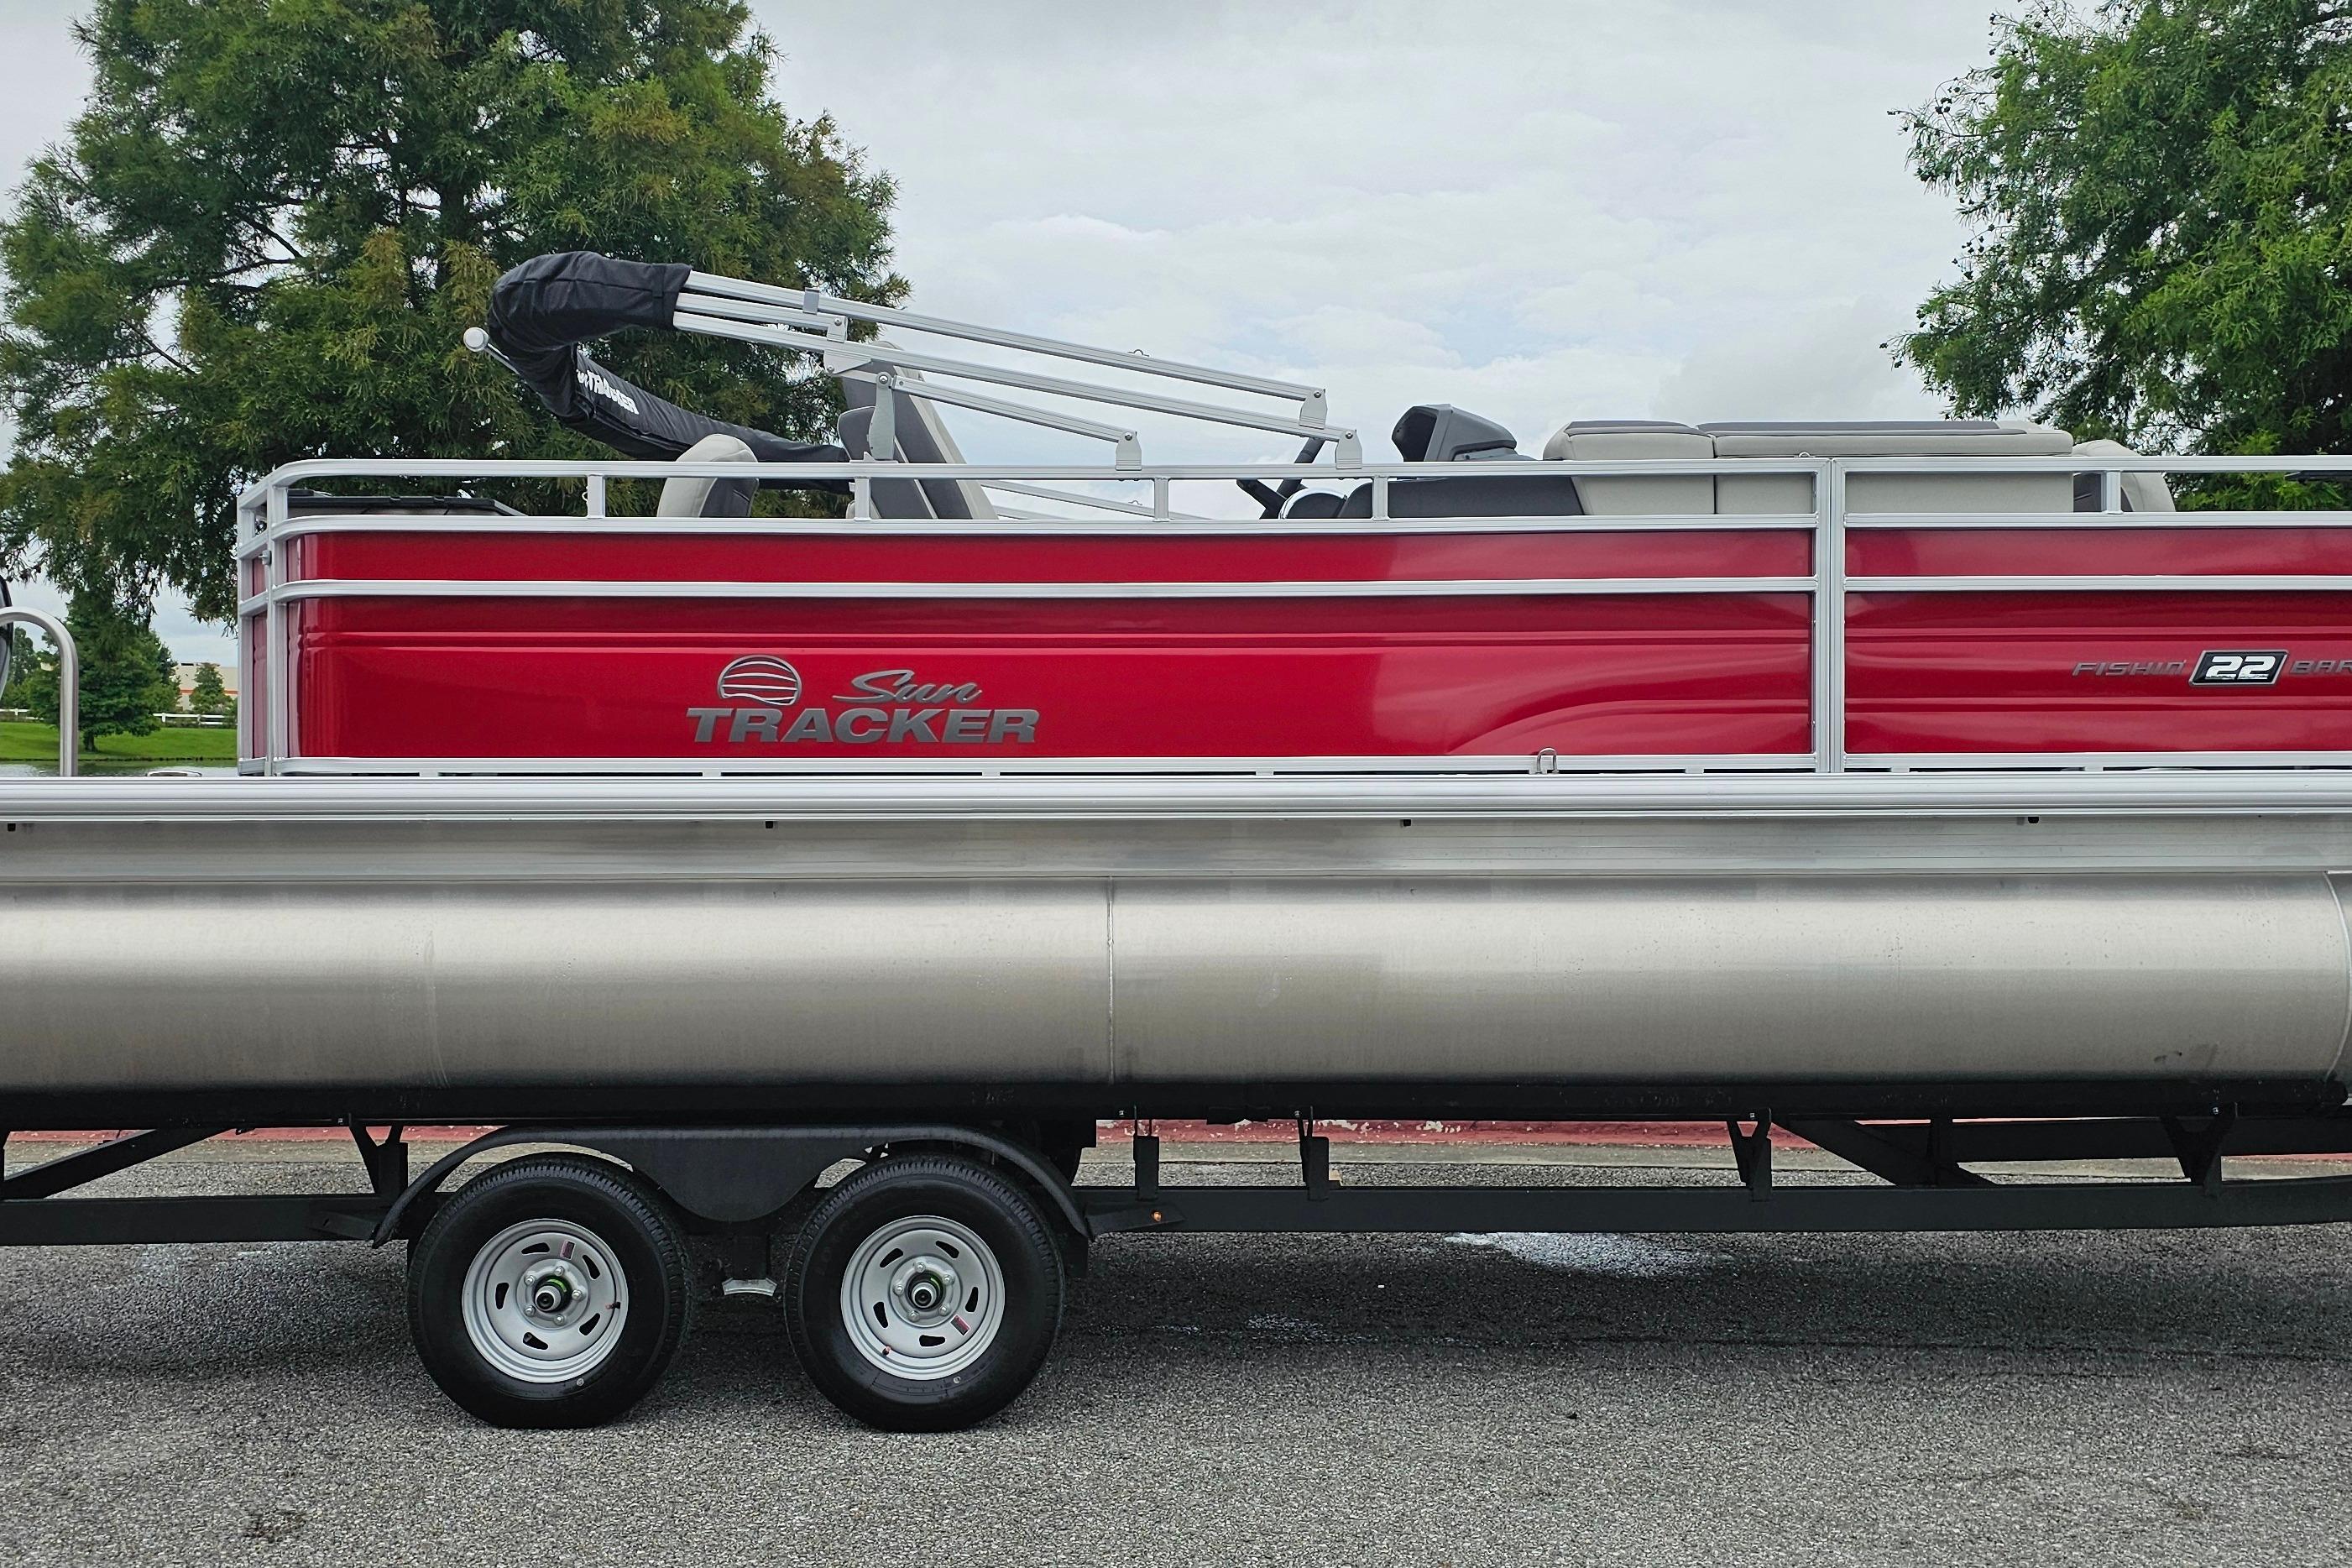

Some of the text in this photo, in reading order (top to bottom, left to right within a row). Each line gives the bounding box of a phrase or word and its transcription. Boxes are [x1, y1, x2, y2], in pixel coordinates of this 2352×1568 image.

[2205, 656, 2276, 680] 22
[833, 669, 982, 703] Sun
[687, 708, 1040, 744] TRACKER
